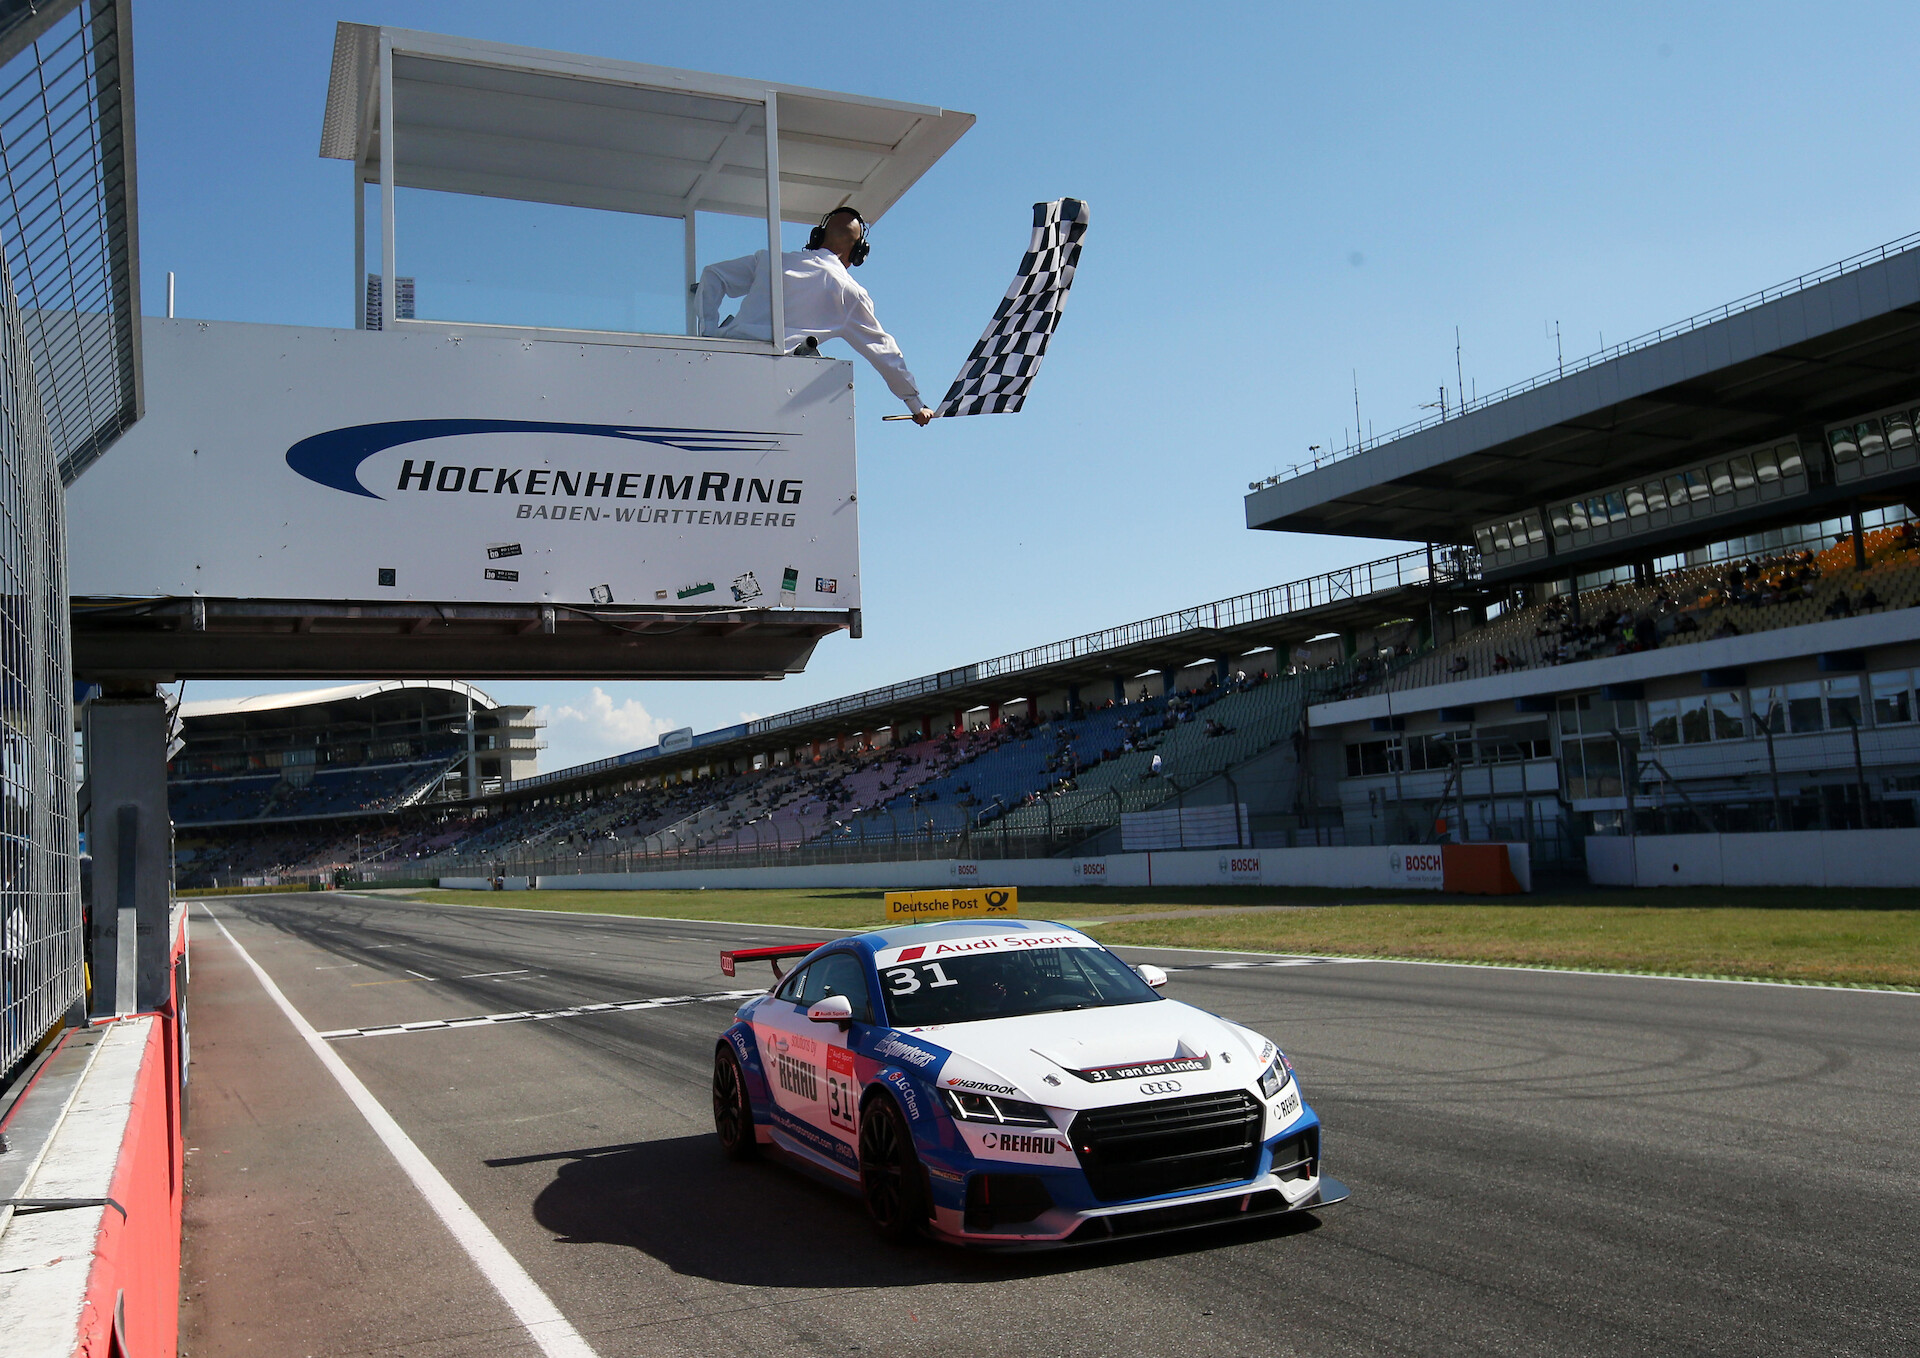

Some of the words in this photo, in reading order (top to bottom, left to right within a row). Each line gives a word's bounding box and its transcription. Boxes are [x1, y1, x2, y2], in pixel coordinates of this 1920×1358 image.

[397, 459, 803, 504] HOCKENHEIMRING
[515, 503, 797, 527] BADEN-WÜRTTEMBERG
[958, 865, 977, 875] BOSCH
[1083, 863, 1105, 875] BOSCH
[1231, 858, 1259, 871] BOSCH
[1405, 855, 1441, 871] BOSCH
[893, 899, 949, 913] Deutsche
[952, 898, 978, 910] Post
[936, 938, 999, 954] Audi
[1004, 935, 1078, 948] Sport
[886, 962, 958, 996] 31
[732, 1030, 742, 1041] LG
[737, 1037, 749, 1061] Chem
[791, 1034, 811, 1053] solutions
[811, 1037, 817, 1056] by
[778, 1053, 818, 1101] REHAU
[1090, 1070, 1112, 1081] 31
[1117, 1067, 1143, 1078] van
[1144, 1063, 1165, 1076] der
[1166, 1060, 1204, 1073] Linde
[829, 1077, 852, 1122] 31
[895, 1077, 911, 1091] LG
[903, 1089, 920, 1121] Chem
[1000, 1134, 1055, 1154] REHAU
